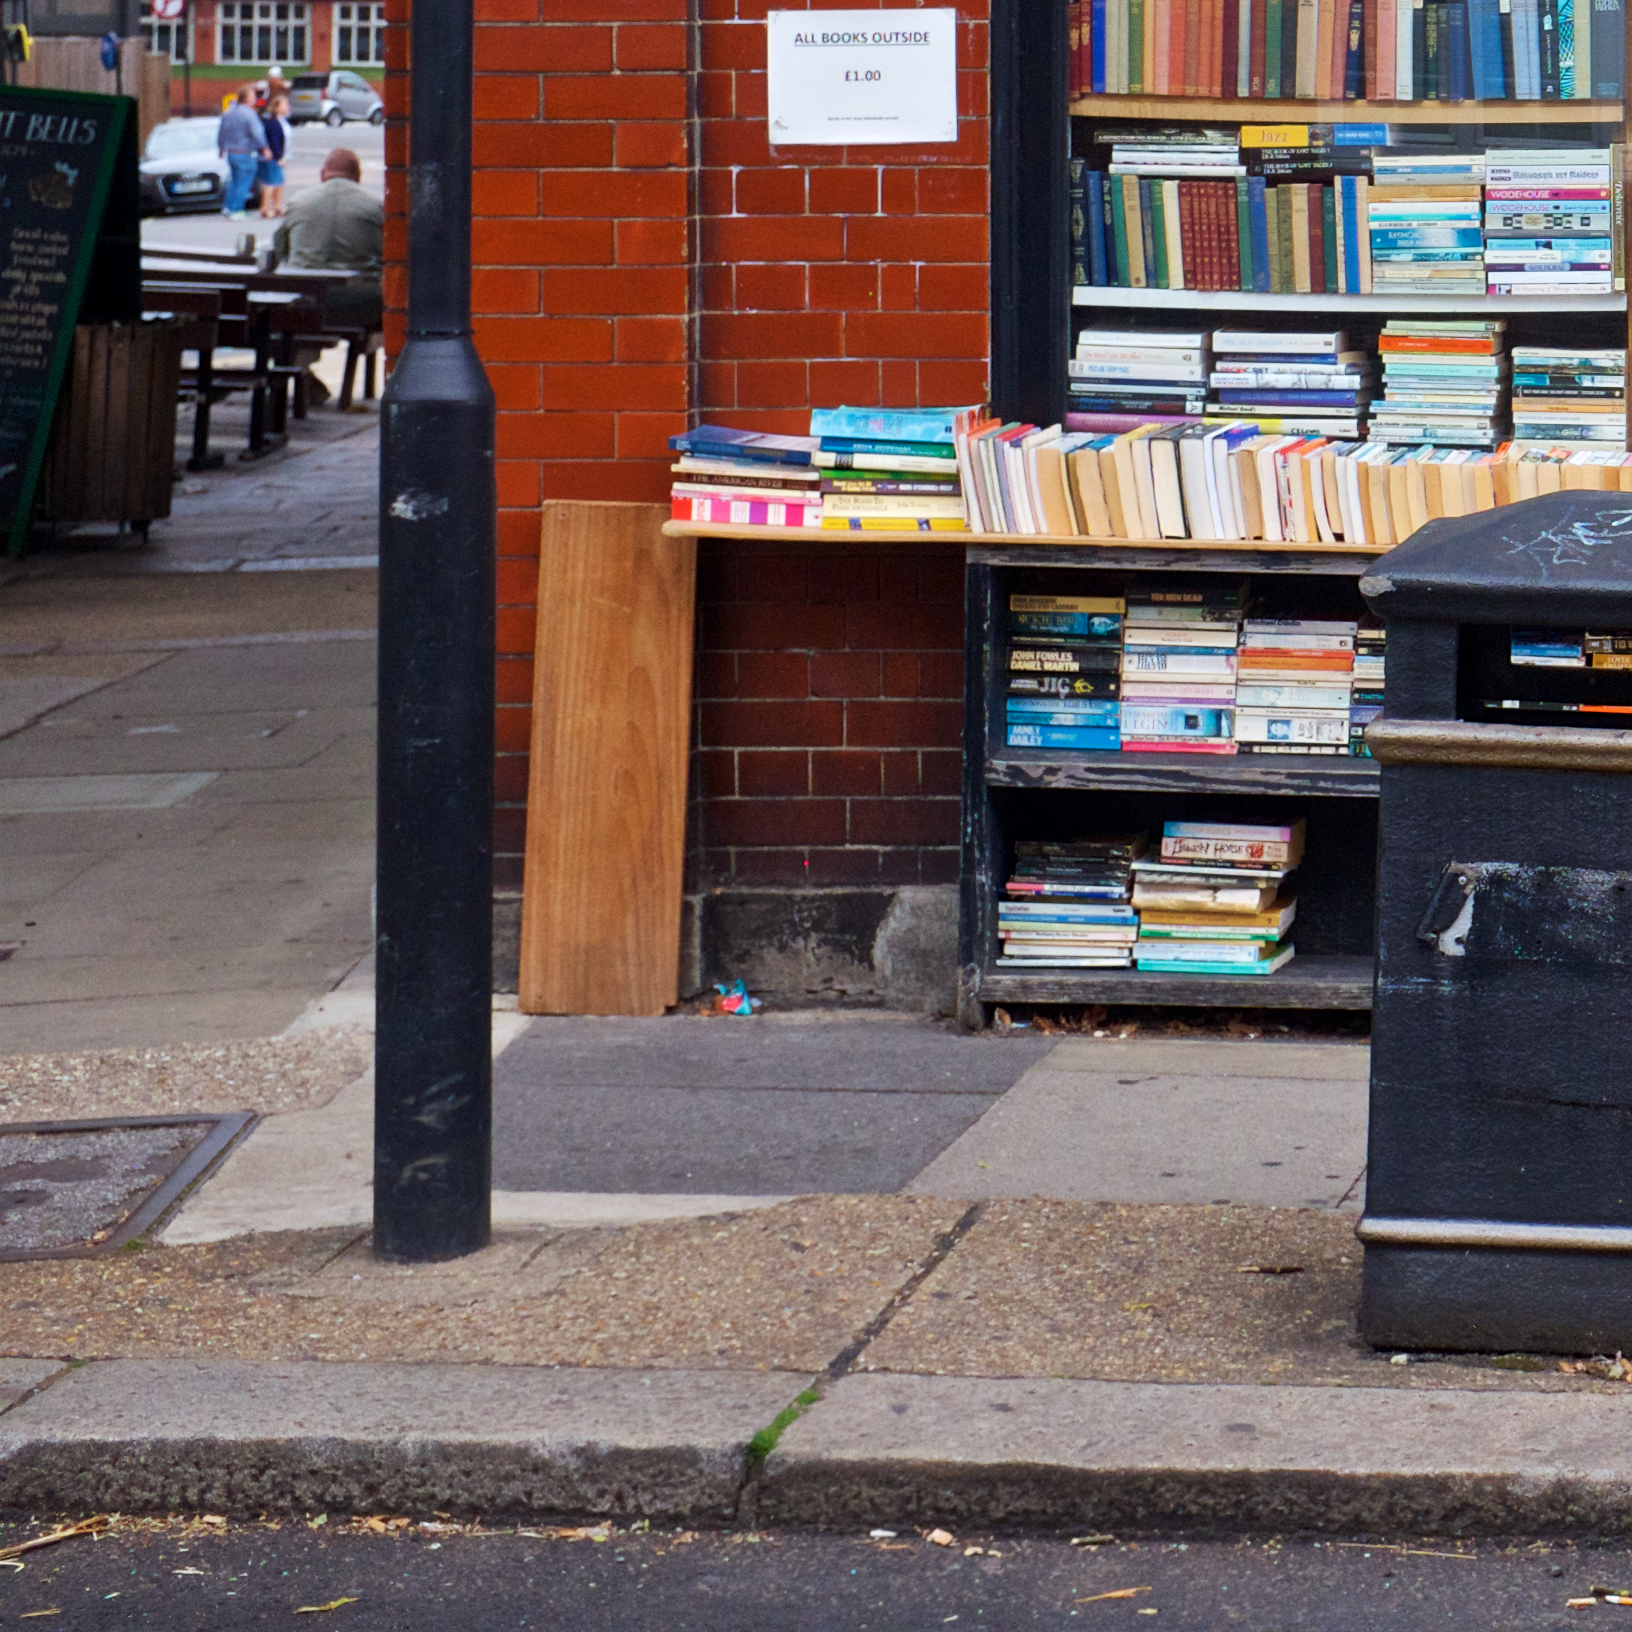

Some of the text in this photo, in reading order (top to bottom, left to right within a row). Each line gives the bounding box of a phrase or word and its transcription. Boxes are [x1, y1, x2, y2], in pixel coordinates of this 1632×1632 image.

[795, 32, 930, 43] ALL BOOKS OUTSIDE
[845, 70, 881, 81] £1.00
[1259, 129, 1288, 143] Jazz
[1490, 190, 1550, 200] WODEHOUSE
[1492, 203, 1550, 213] WODEHOUSE
[1010, 652, 1074, 662] JOHN FOWLES
[1010, 661, 1080, 672] DANIEL MARTIN
[1009, 734, 1043, 746] DAILEY
